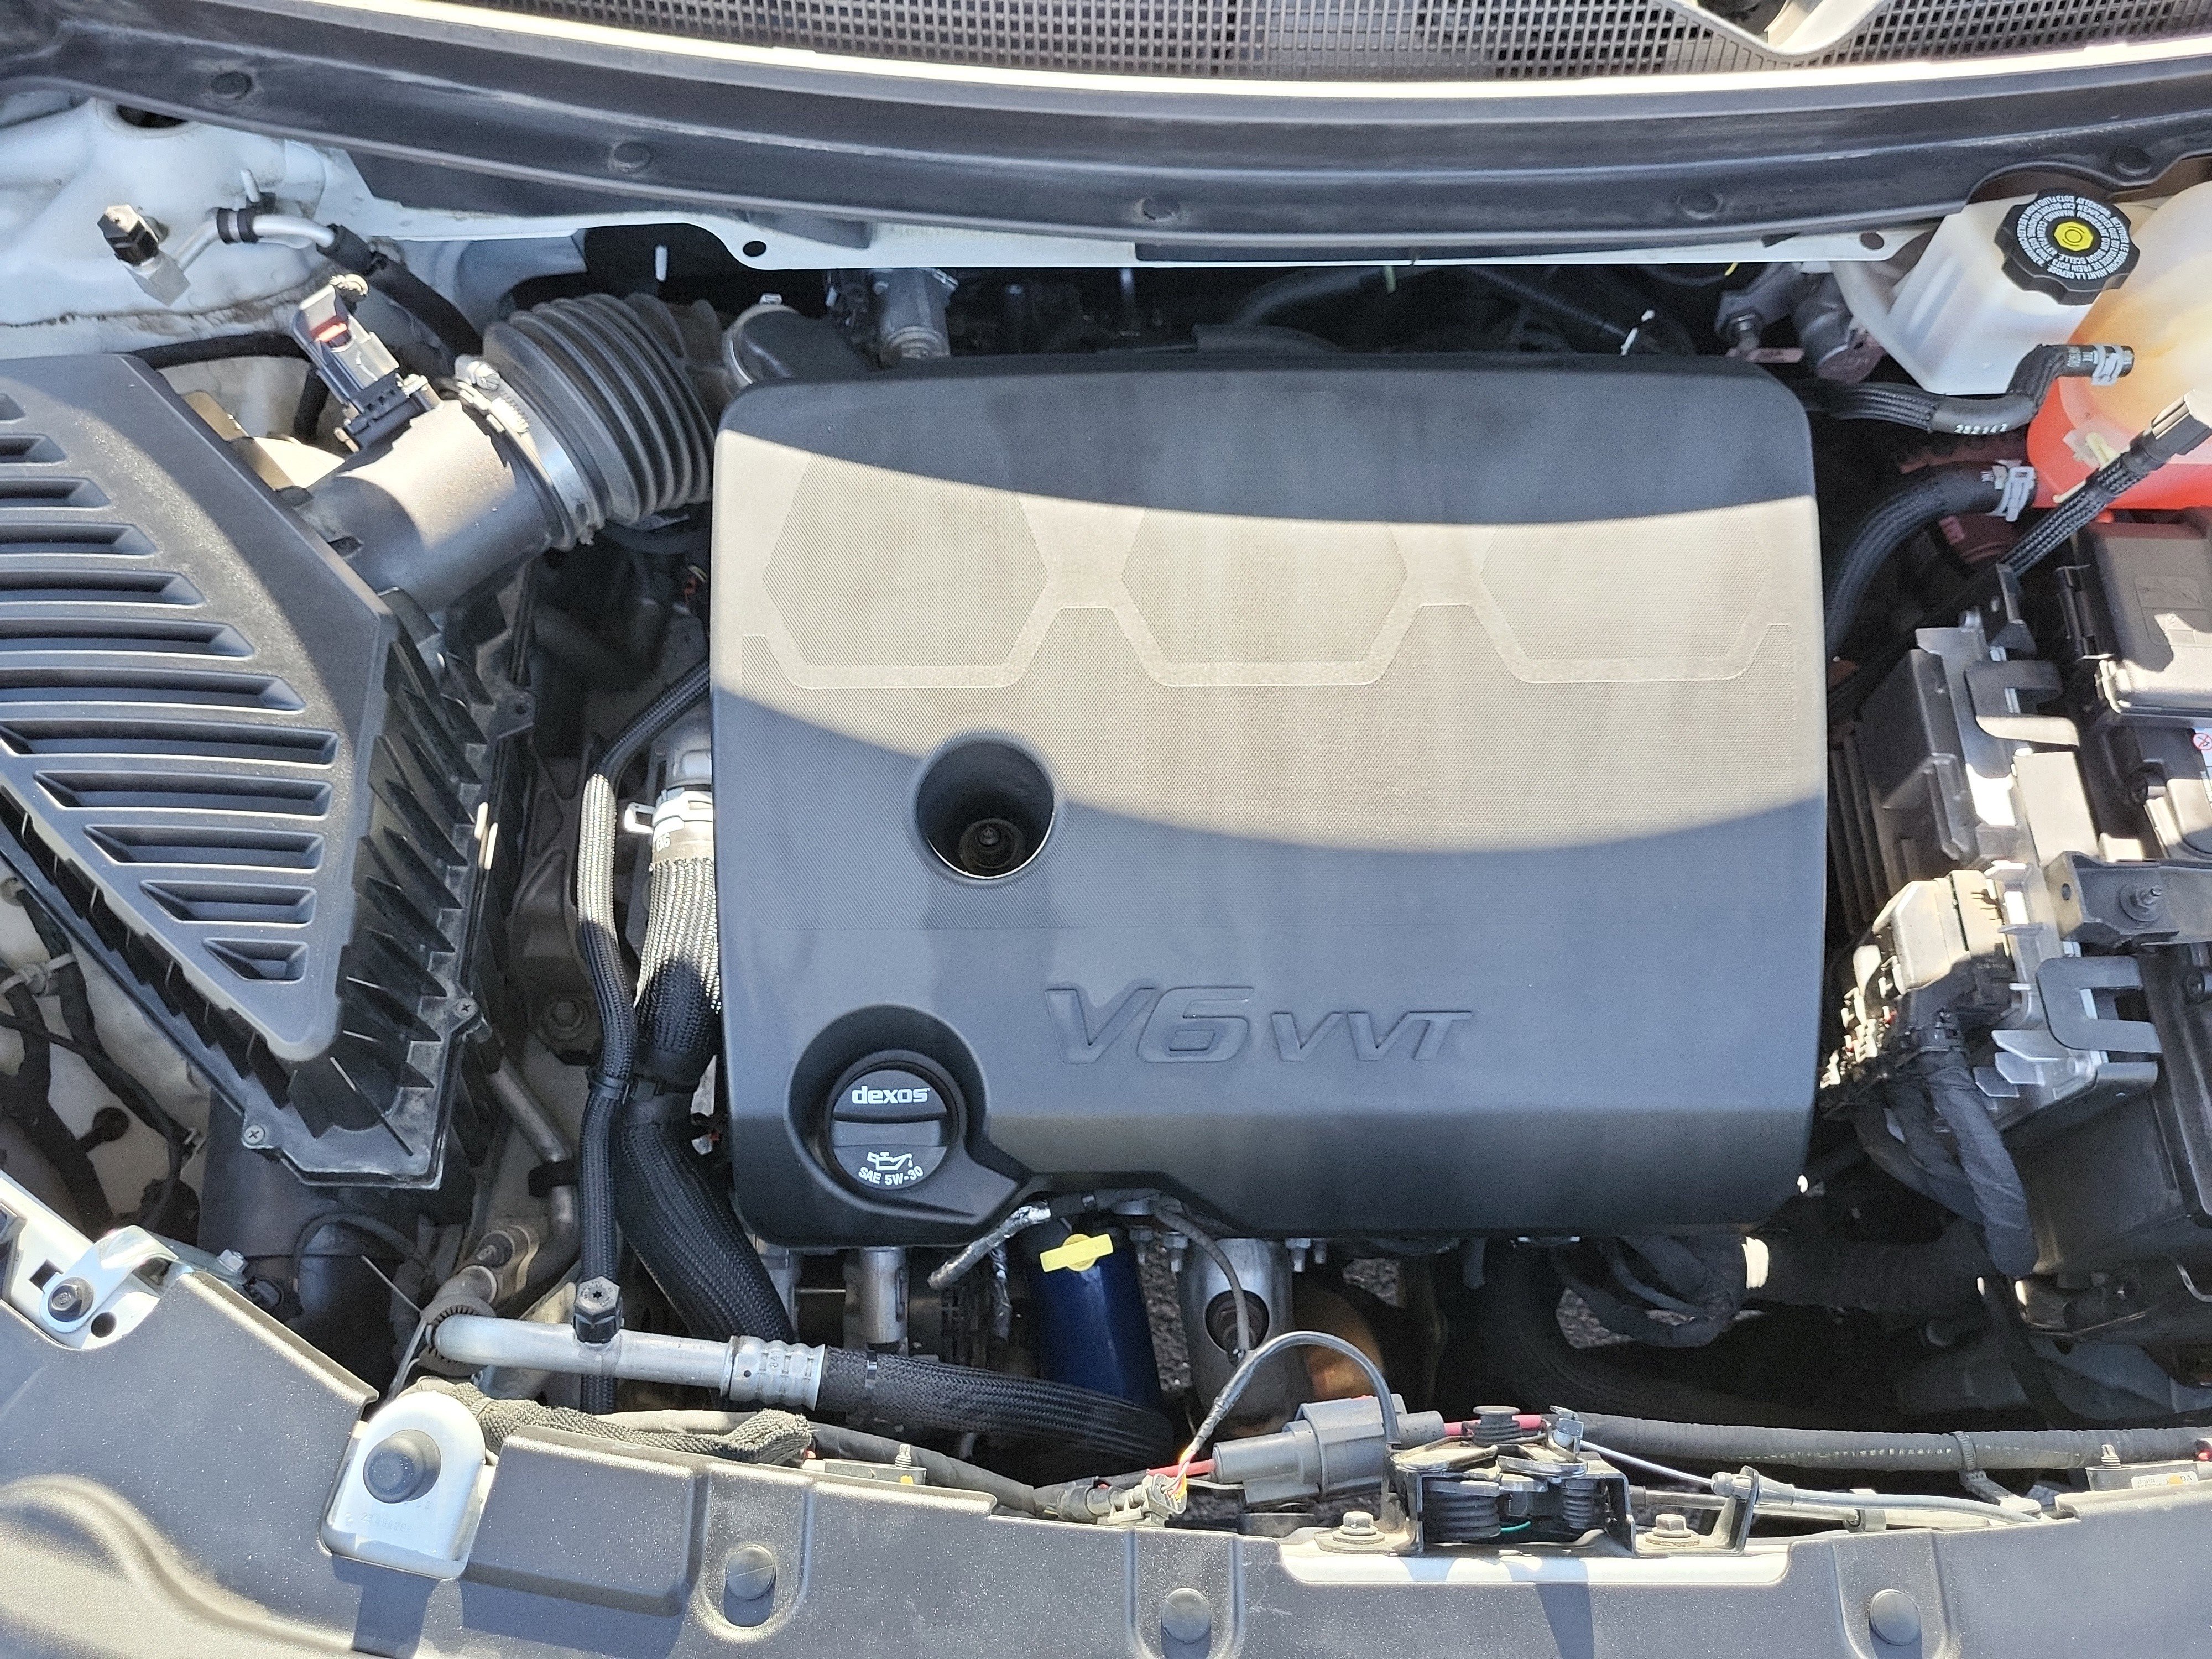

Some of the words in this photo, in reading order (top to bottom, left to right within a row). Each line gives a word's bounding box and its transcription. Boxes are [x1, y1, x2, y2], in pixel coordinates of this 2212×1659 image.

[2037, 196, 2057, 207] FLUID
[2062, 202, 2075, 210] CAP
[2023, 201, 2042, 217] FROM
[2037, 202, 2062, 216] BEFORE
[2016, 217, 2028, 238] SEALED
[2107, 227, 2120, 240] QUE
[2028, 237, 2041, 250] USE
[2037, 237, 2058, 257] FILLER
[2110, 239, 2120, 249] DU
[2120, 243, 2130, 252] LE
[2036, 248, 2054, 262] ONLY
[2085, 249, 2106, 264] BIDON
[2099, 247, 2119, 267] LIQUIDE
[2051, 258, 2071, 270] DOT3
[2071, 264, 2093, 272] FREIN
[2091, 262, 2103, 271] DE
[2104, 251, 2128, 274] BOUCHON
[2075, 272, 2086, 280] LA
[2086, 268, 2108, 280] AVANT
[1045, 986, 1254, 1064] V6
[1271, 1010, 1473, 1062] VVT
[851, 1085, 929, 1104] dexos
[858, 1166, 882, 1185] SAE
[885, 1165, 924, 1186] 5W-30
